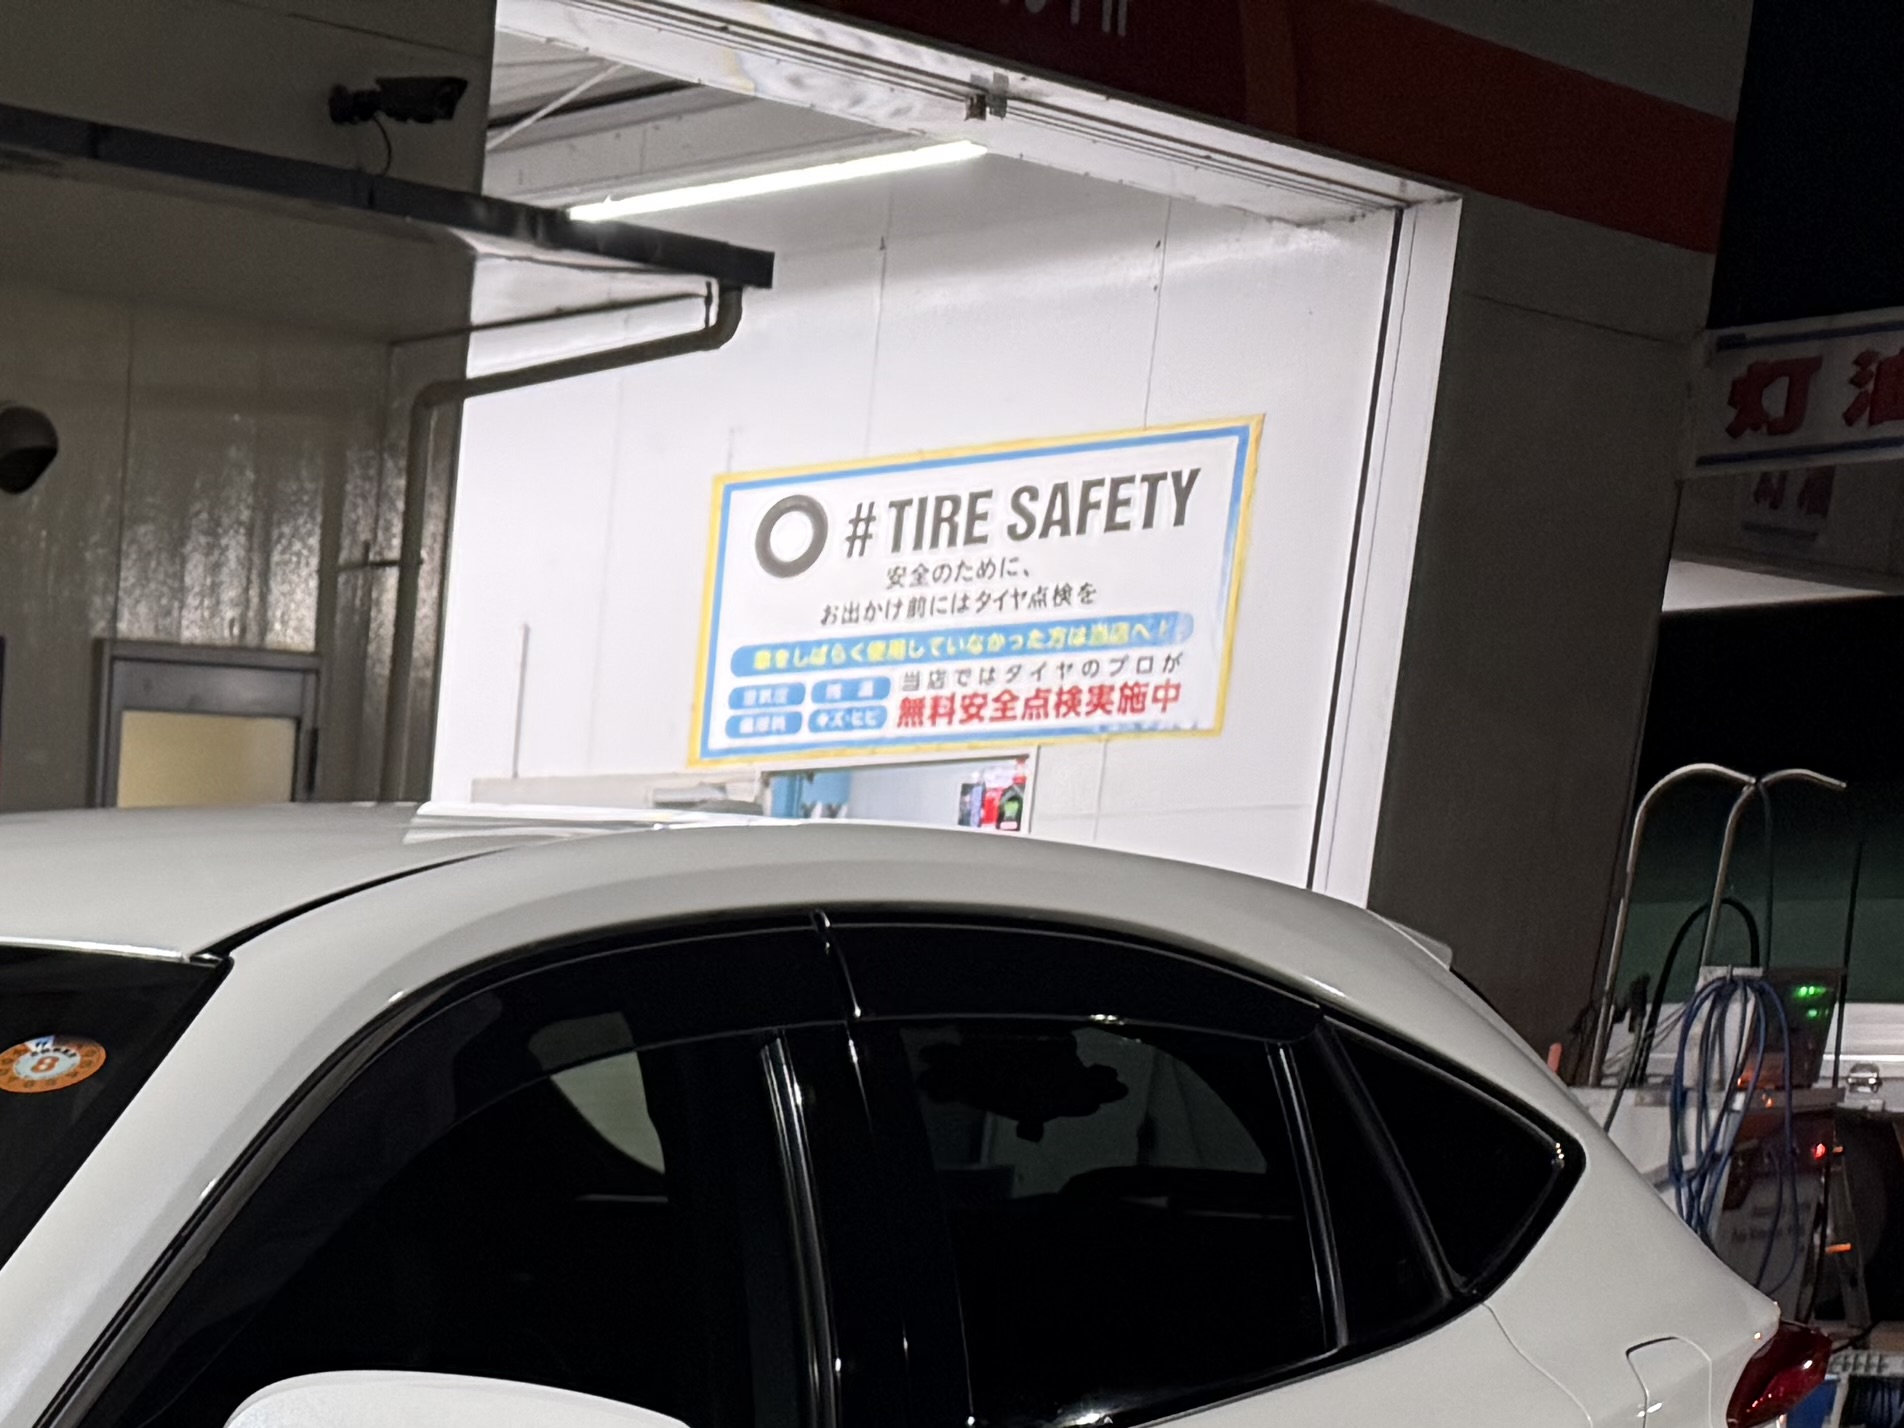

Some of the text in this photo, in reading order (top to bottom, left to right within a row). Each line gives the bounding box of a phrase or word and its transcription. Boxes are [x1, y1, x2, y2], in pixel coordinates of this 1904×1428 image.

[1007, 468, 1201, 541] SAFETY
[886, 557, 1031, 590] 安全のために、
[821, 582, 1097, 626] お出かけ前にはタイヤ点検を
[902, 652, 1183, 692] 当店ではタイヤのプロが
[897, 680, 1181, 728] 無料安全点検実施中
